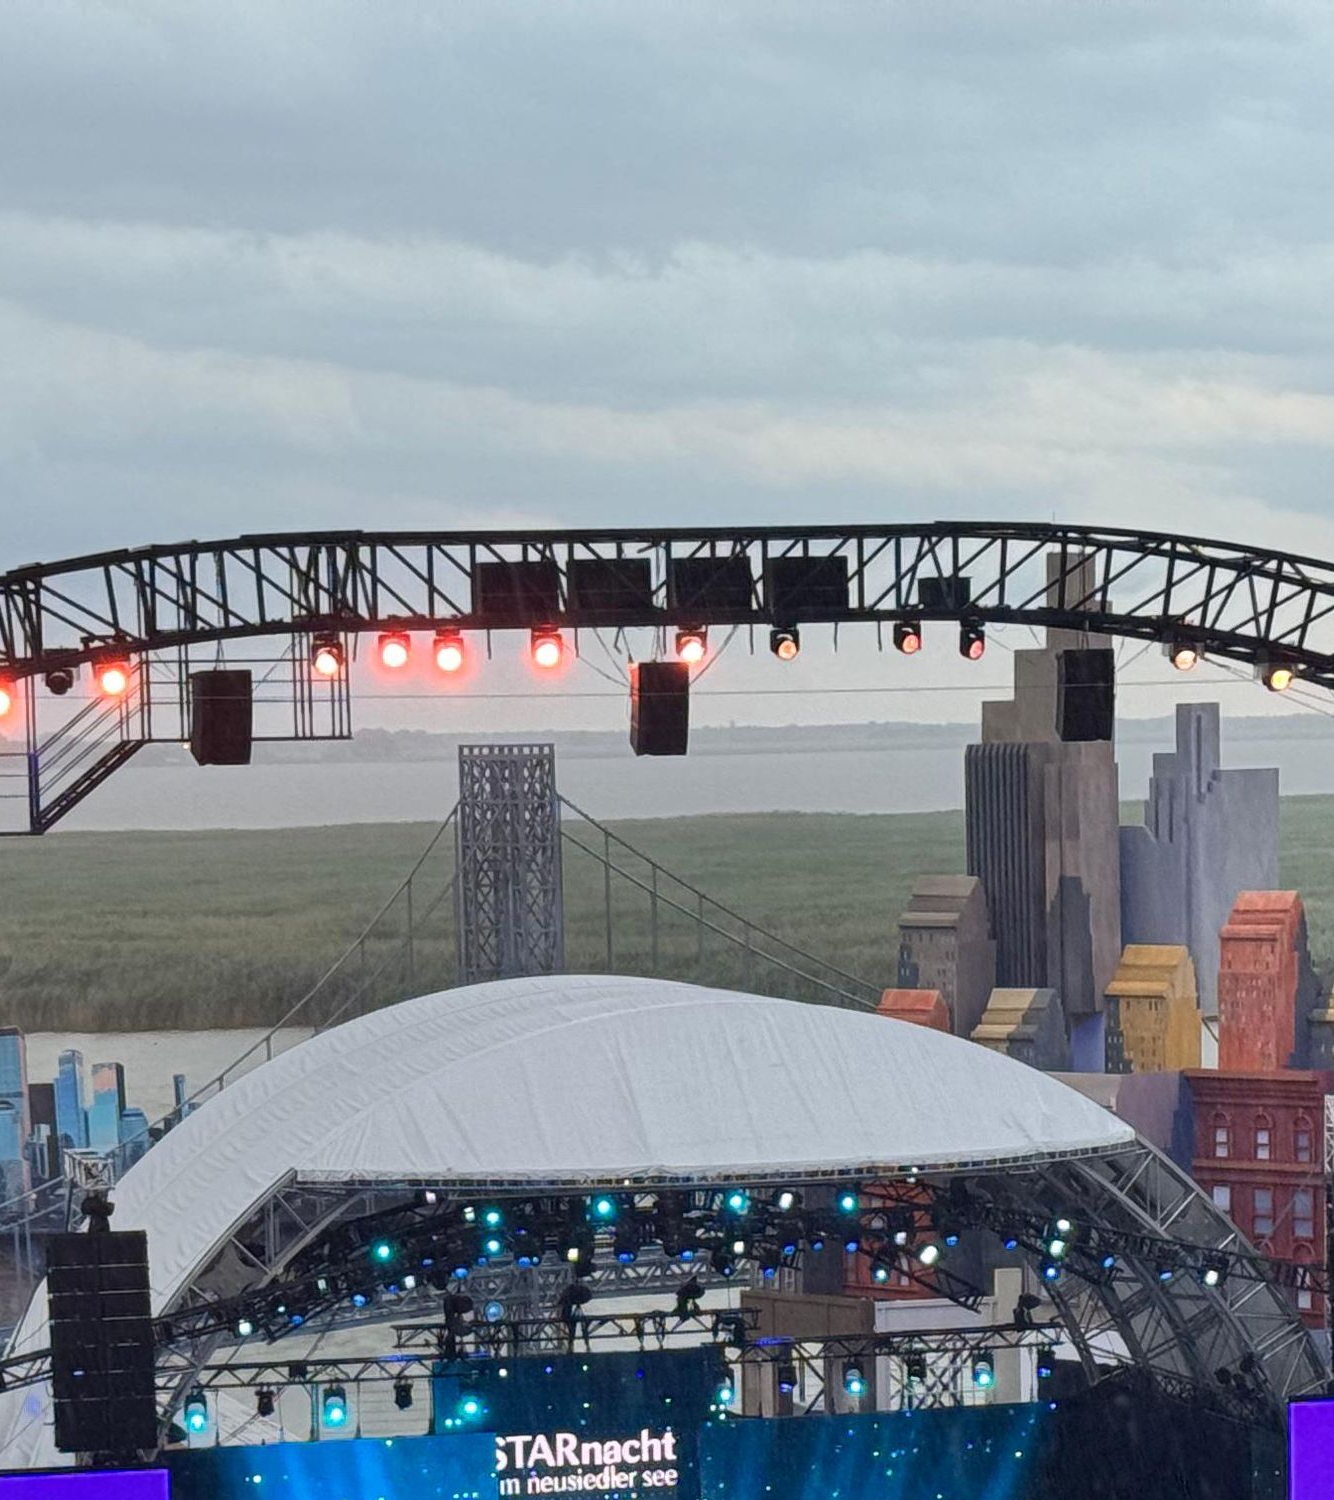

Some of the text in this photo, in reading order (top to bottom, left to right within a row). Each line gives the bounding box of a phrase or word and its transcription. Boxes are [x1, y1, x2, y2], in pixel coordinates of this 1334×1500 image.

[499, 1467, 679, 1495] m neusiedler see
